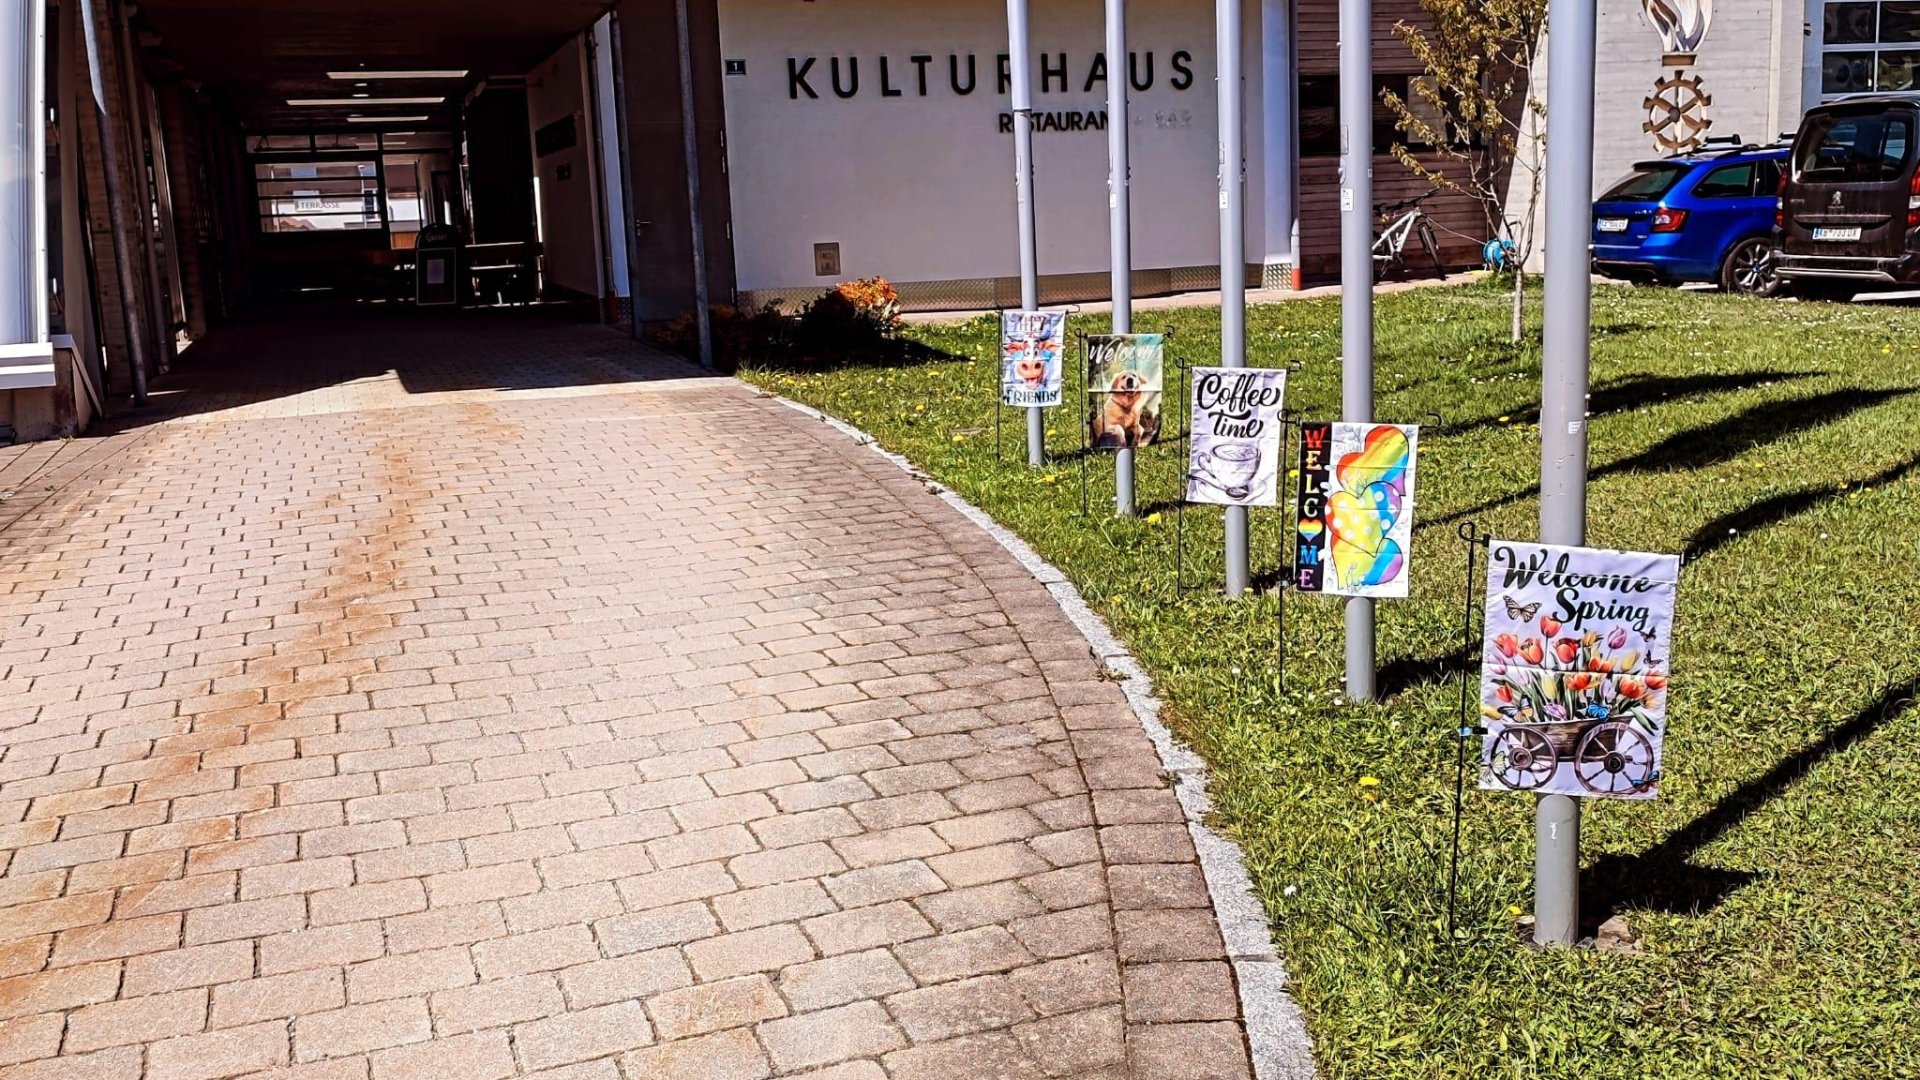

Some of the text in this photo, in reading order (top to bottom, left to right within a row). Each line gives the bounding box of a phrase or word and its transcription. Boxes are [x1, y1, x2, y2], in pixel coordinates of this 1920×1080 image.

[787, 51, 1193, 99] KULTURHAUS
[998, 111, 1108, 132] RTAURAN
[1005, 388, 1059, 404] FRIENDS
[1197, 373, 1280, 412] Coffee
[1494, 546, 1660, 594] Welcome
[1552, 587, 1650, 632] Spring
